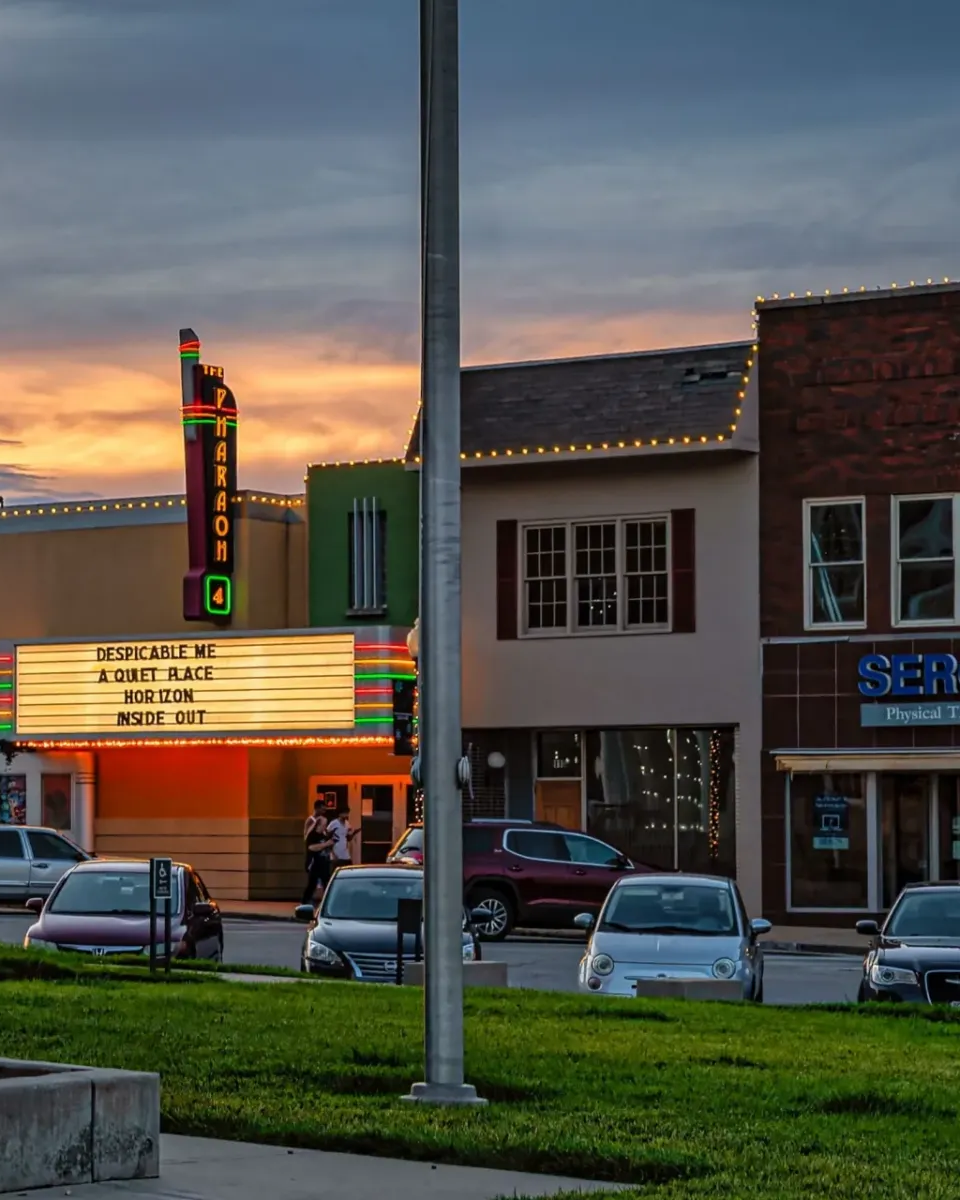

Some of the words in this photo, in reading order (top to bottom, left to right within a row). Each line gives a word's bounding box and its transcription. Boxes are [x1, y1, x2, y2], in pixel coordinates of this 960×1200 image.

[203, 365, 224, 378] THE
[214, 386, 229, 563] PHARAOH
[212, 585, 224, 605] 4
[96, 644, 188, 662] DESPICABLE
[194, 643, 216, 659] ME
[98, 668, 109, 684] A
[114, 667, 158, 683] QUIET
[168, 665, 214, 681] PLACE
[857, 653, 960, 697] SER
[116, 711, 165, 727] INSIDE
[175, 709, 207, 725] OUT
[886, 705, 941, 724] Physical
